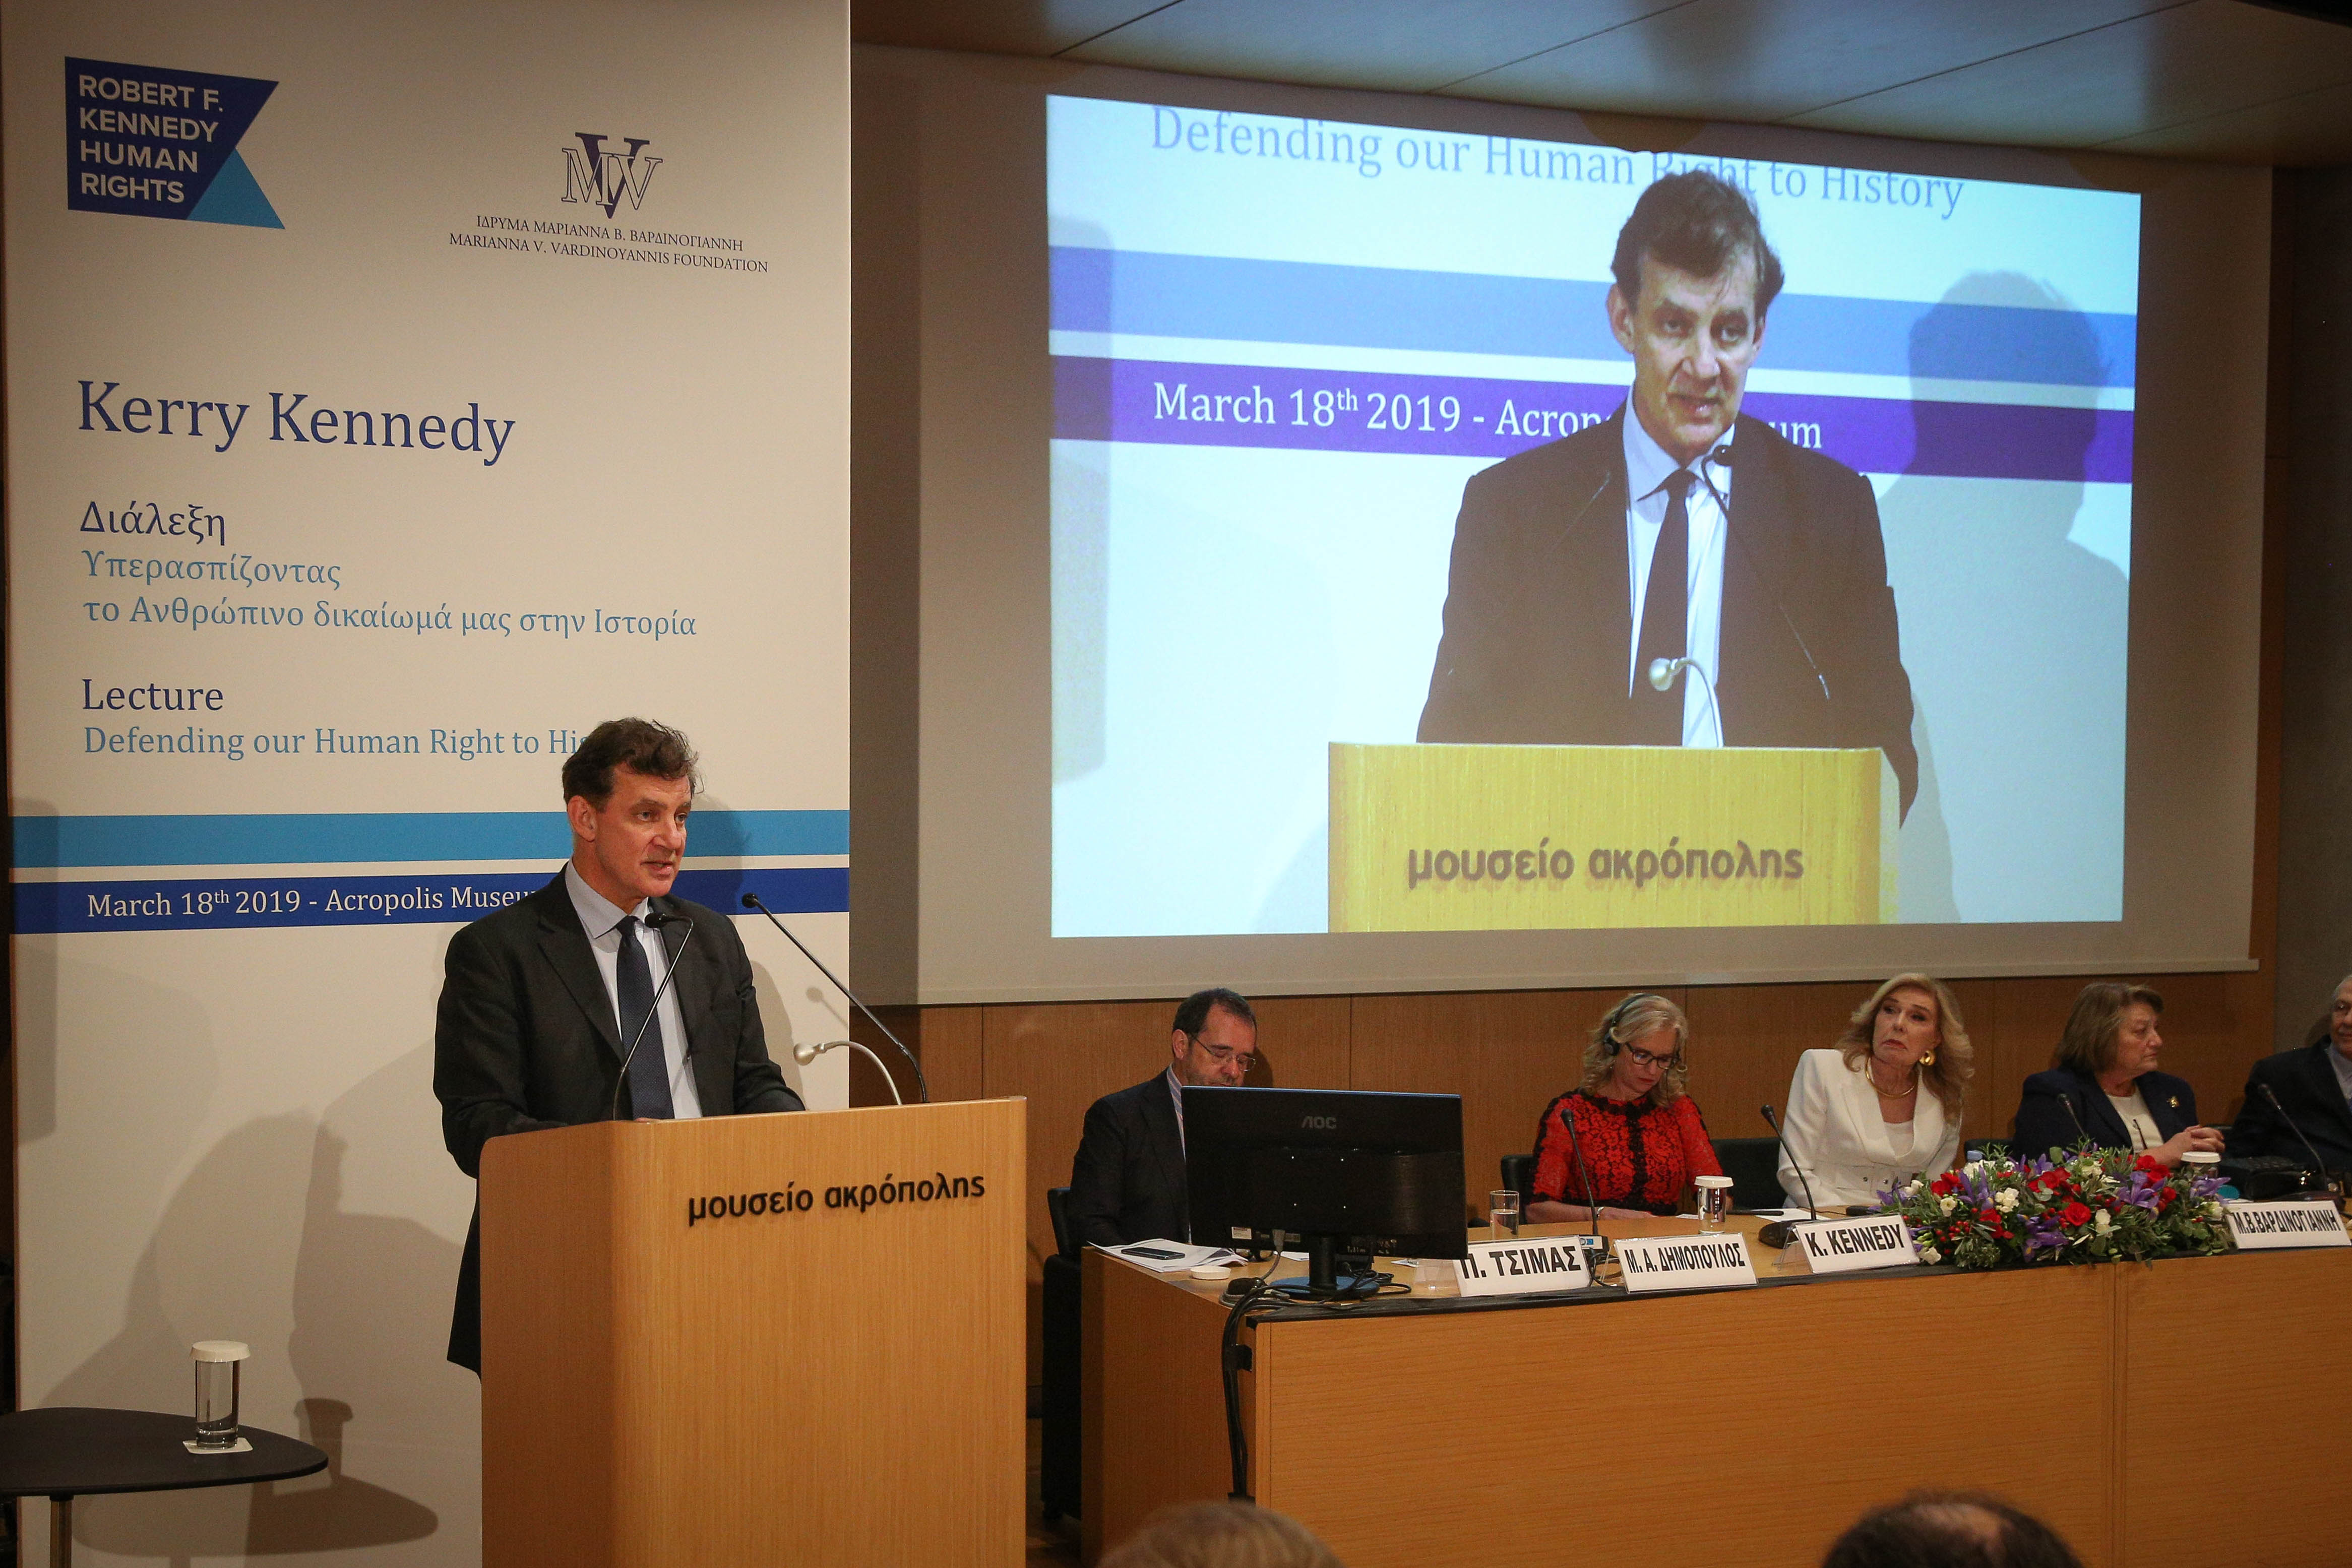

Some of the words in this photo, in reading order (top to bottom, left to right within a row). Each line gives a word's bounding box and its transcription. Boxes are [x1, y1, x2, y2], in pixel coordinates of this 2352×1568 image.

[79, 74, 195, 109] ROBERT
[203, 88, 223, 112] F.
[79, 107, 219, 143] KENNEDY
[80, 139, 198, 173] HUMAN
[1152, 105, 1382, 178] Defending
[1396, 137, 1470, 172] our
[1485, 136, 1635, 185] Human
[1769, 162, 1807, 198] to
[1821, 165, 1965, 220] History
[81, 172, 185, 204] RIGHTS
[476, 215, 530, 232] ΙΔΡΥΜΑ
[533, 221, 610, 239] ΜΑΡΙΑΝΝΑ
[630, 230, 744, 252] ΒΑΡΔΙΝΟΓΙΑΝΝΗ
[449, 232, 530, 253] MARIANNA
[533, 240, 546, 254] V.
[552, 241, 670, 265] VARDINOYANNIS
[673, 253, 769, 273] FOUNDATION
[78, 380, 250, 453] Kerry
[269, 392, 516, 466] Kennedy
[1153, 382, 1276, 425] March
[1366, 392, 1461, 432] 2019
[80, 500, 226, 546] Διάλεξη
[81, 549, 341, 591] Υπερασπίζοντας
[83, 600, 119, 622] το
[129, 596, 303, 631] Ανθρώπινο
[314, 600, 452, 636] δικαίωμά
[462, 610, 511, 638] μας
[520, 612, 586, 639] στην
[594, 608, 697, 641] Ιστορία
[82, 678, 224, 711] Lecture
[84, 726, 244, 761] Defending
[254, 734, 305, 754] our
[315, 728, 420, 754] Human
[429, 728, 505, 761] Right
[512, 732, 539, 754] to
[1408, 837, 1575, 890] μουσείο
[1588, 836, 1805, 888] ακρόπολης
[87, 892, 172, 917] March
[235, 889, 301, 914] 2019
[325, 887, 443, 916] Acropolis
[688, 1181, 814, 1227] μουσείο
[824, 1173, 985, 1213] ακρόπολης
[1657, 1242, 1746, 1272] ΔΗΜΟΠΟΥΛΟΣ
[1826, 1223, 1905, 1255] KENNEDY
[1489, 1245, 1582, 1276] ΤΣΙΜΑΣ
